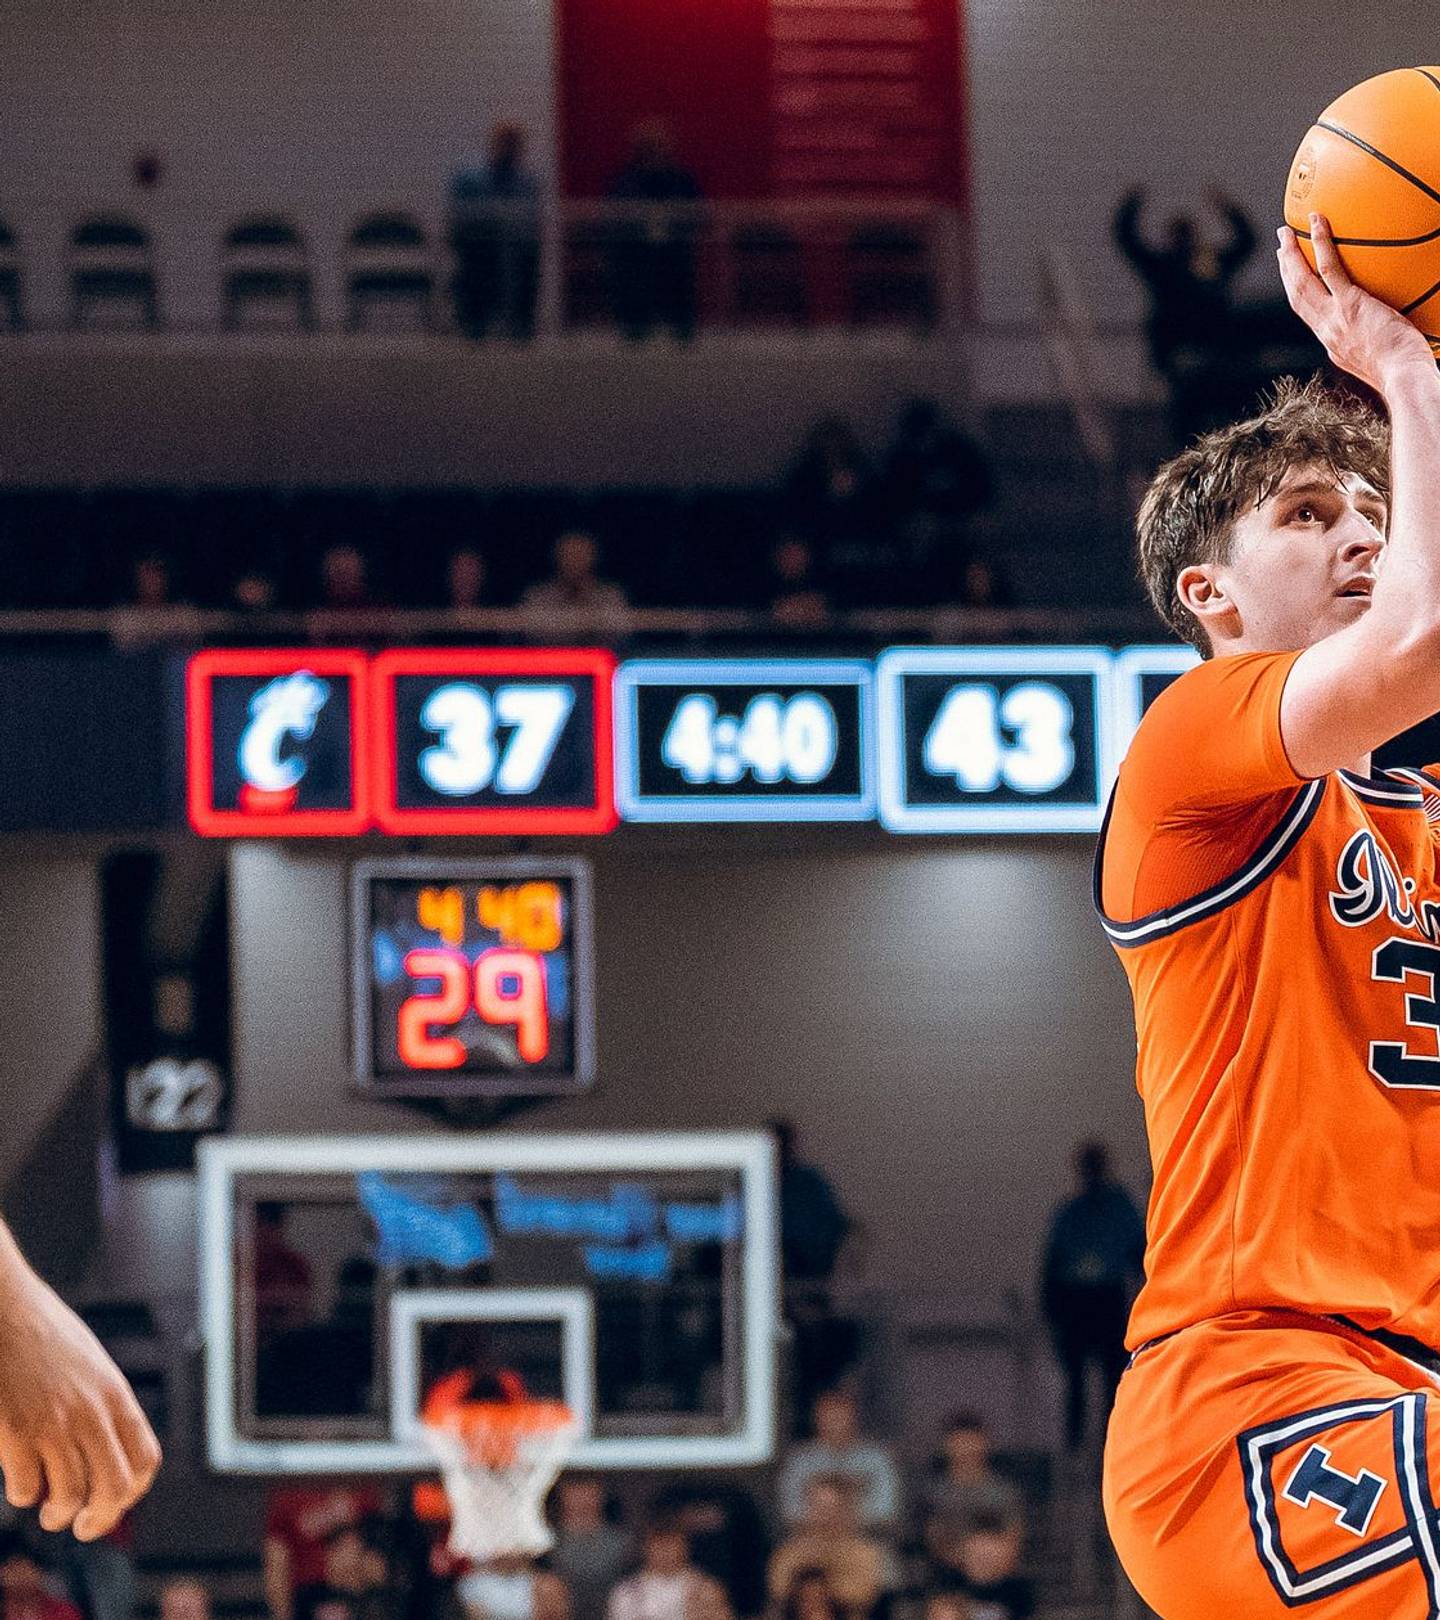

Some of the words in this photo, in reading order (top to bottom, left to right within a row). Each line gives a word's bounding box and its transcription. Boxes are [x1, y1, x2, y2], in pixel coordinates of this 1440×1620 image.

[419, 682, 577, 797] 37
[662, 693, 838, 783] 4:40
[923, 682, 1075, 794] 43
[398, 948, 550, 1070] 29
